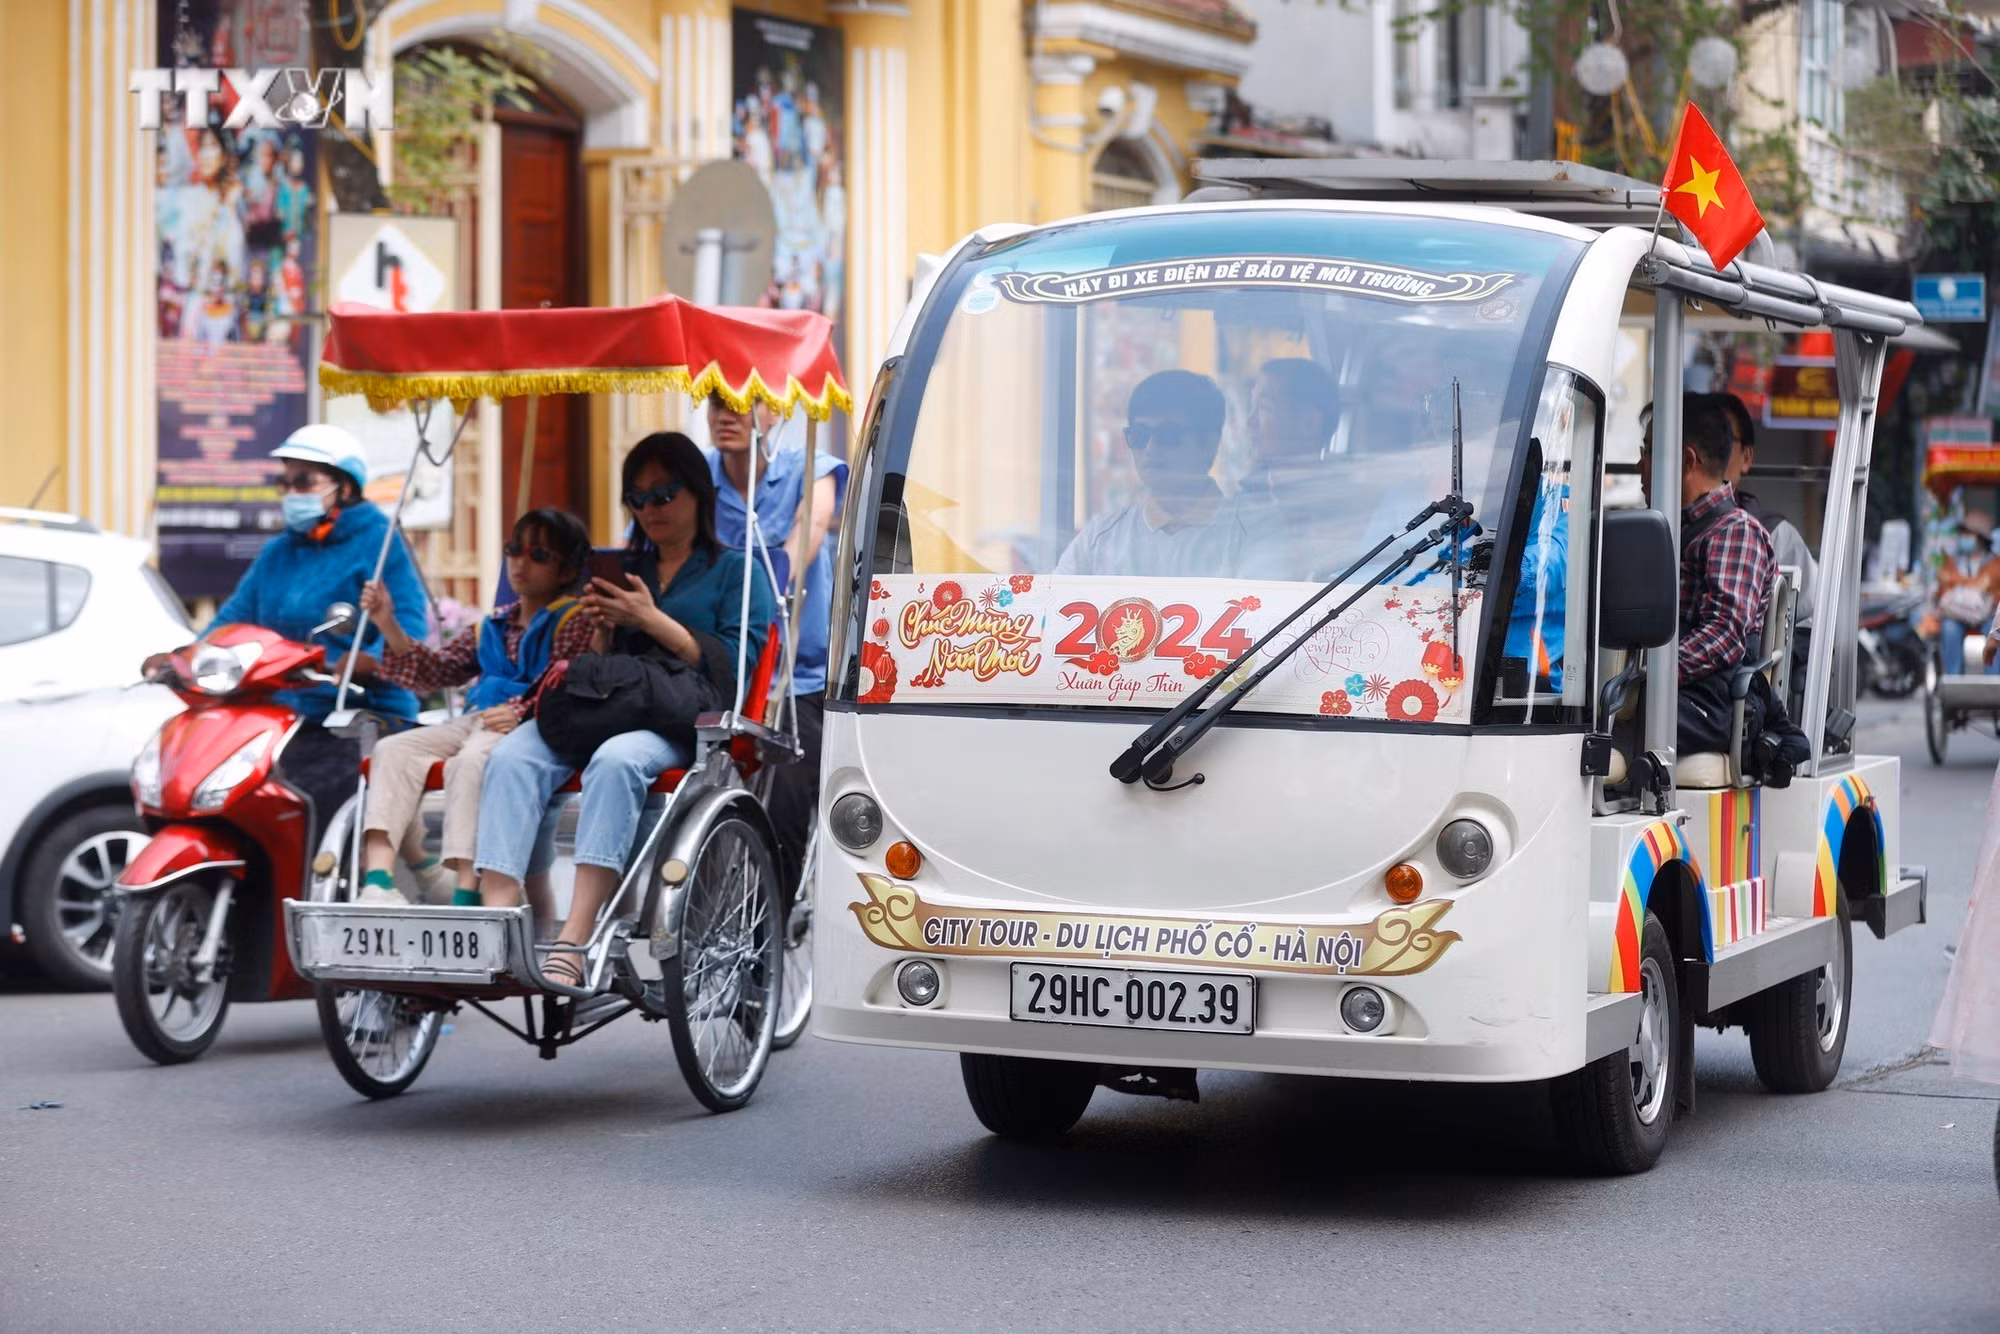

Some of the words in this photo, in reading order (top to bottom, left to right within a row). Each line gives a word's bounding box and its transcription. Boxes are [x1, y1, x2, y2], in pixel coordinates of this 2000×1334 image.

[1064, 277, 1103, 297] HÃY
[1108, 271, 1128, 289] ĐI
[1133, 268, 1159, 285] XE
[1164, 263, 1210, 284] ĐIỆN
[1214, 259, 1246, 279] ĐỂ
[1244, 259, 1285, 279] BẢO
[1290, 262, 1315, 283] VỆ
[1316, 266, 1358, 284] MÔI
[1360, 270, 1437, 298] TRƯỜNG
[898, 599, 960, 649] Chúc
[949, 598, 1042, 645] Mừng
[1053, 597, 1257, 663] 2024
[922, 637, 978, 684] Năm
[973, 635, 1042, 683] Mới
[1056, 671, 1104, 692] Xuân
[1108, 674, 1142, 702] Giáp
[1145, 671, 1186, 693] Thìn
[923, 917, 974, 946] CITY
[979, 919, 1039, 947] TOUR
[1056, 922, 1090, 949] DU
[1095, 924, 1150, 957] LỊCH
[1155, 921, 1213, 956] PHỐ
[1214, 922, 1258, 959] CỔ
[1273, 928, 1308, 963] HÀ
[1316, 931, 1363, 974] NỘI
[1028, 972, 1239, 1025] 29HC-002.39
